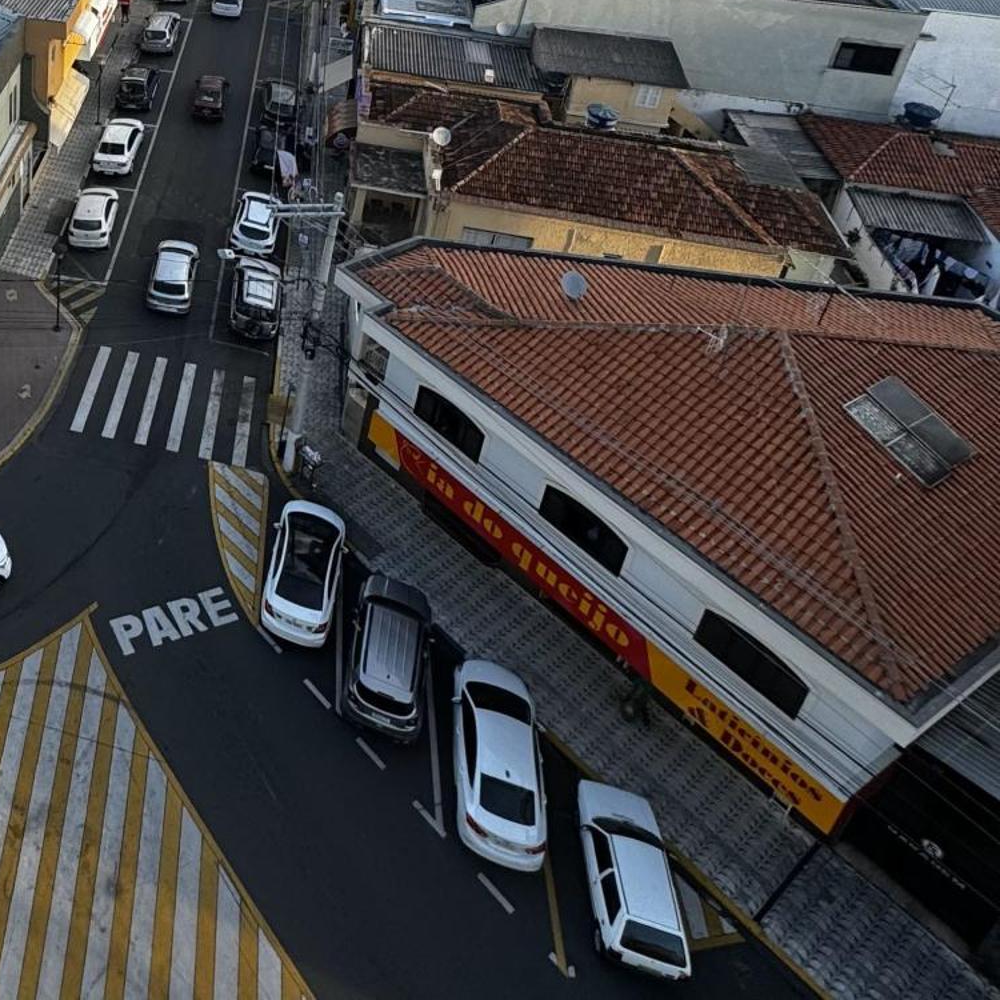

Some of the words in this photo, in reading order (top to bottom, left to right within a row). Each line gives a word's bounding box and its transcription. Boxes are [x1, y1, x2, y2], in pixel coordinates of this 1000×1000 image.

[463, 498, 503, 539] do
[511, 541, 630, 648] queijo
[108, 586, 239, 656] PARE
[720, 728, 802, 806] Doces
